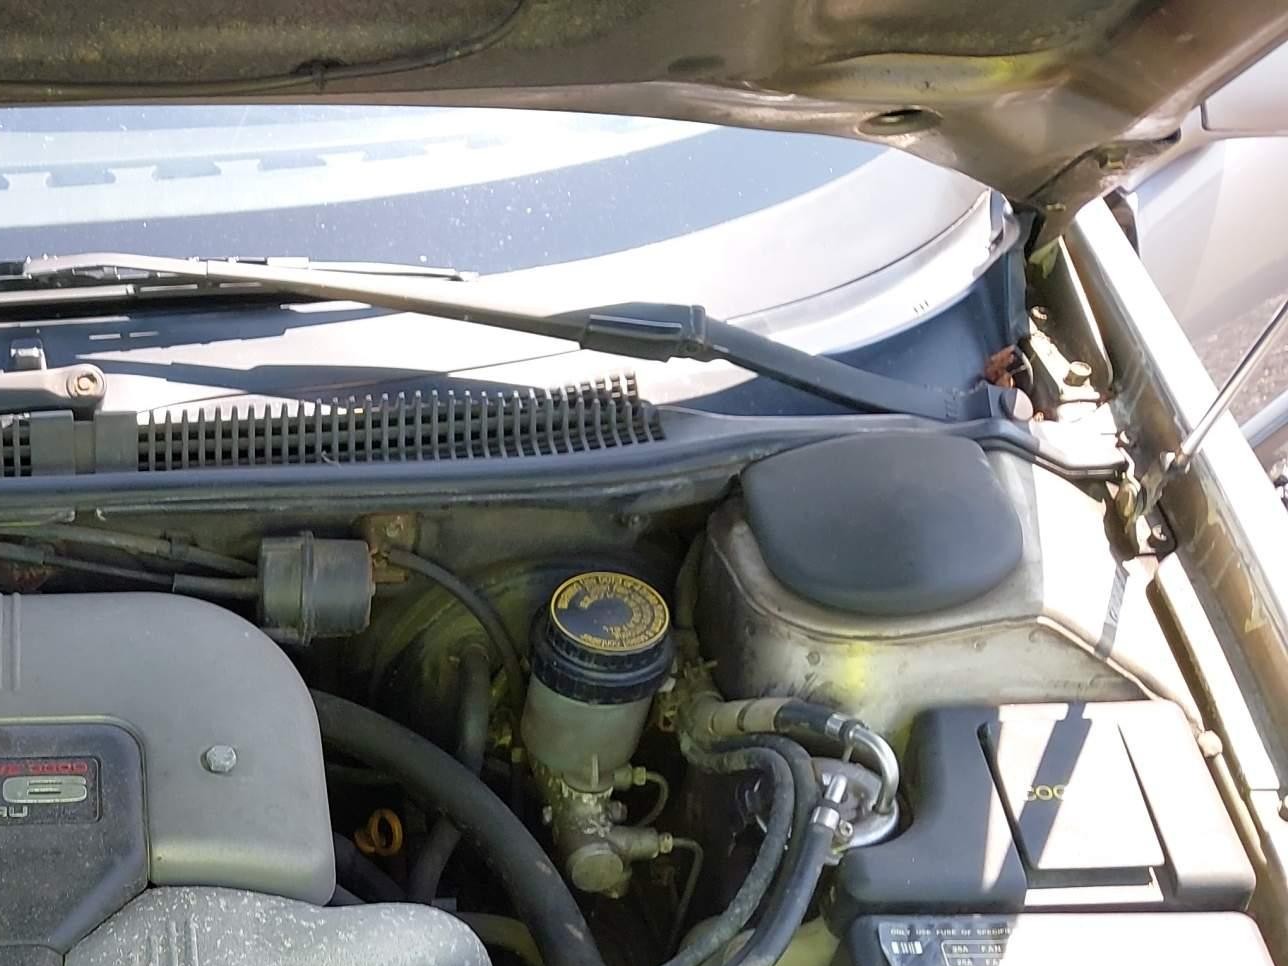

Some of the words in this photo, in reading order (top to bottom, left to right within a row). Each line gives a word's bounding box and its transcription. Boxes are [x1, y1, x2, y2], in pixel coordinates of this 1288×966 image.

[890, 928, 910, 936] ONLY
[915, 928, 931, 936] USE
[936, 928, 956, 936] FUSE
[961, 928, 971, 936] OF
[981, 944, 1001, 953] FAN
